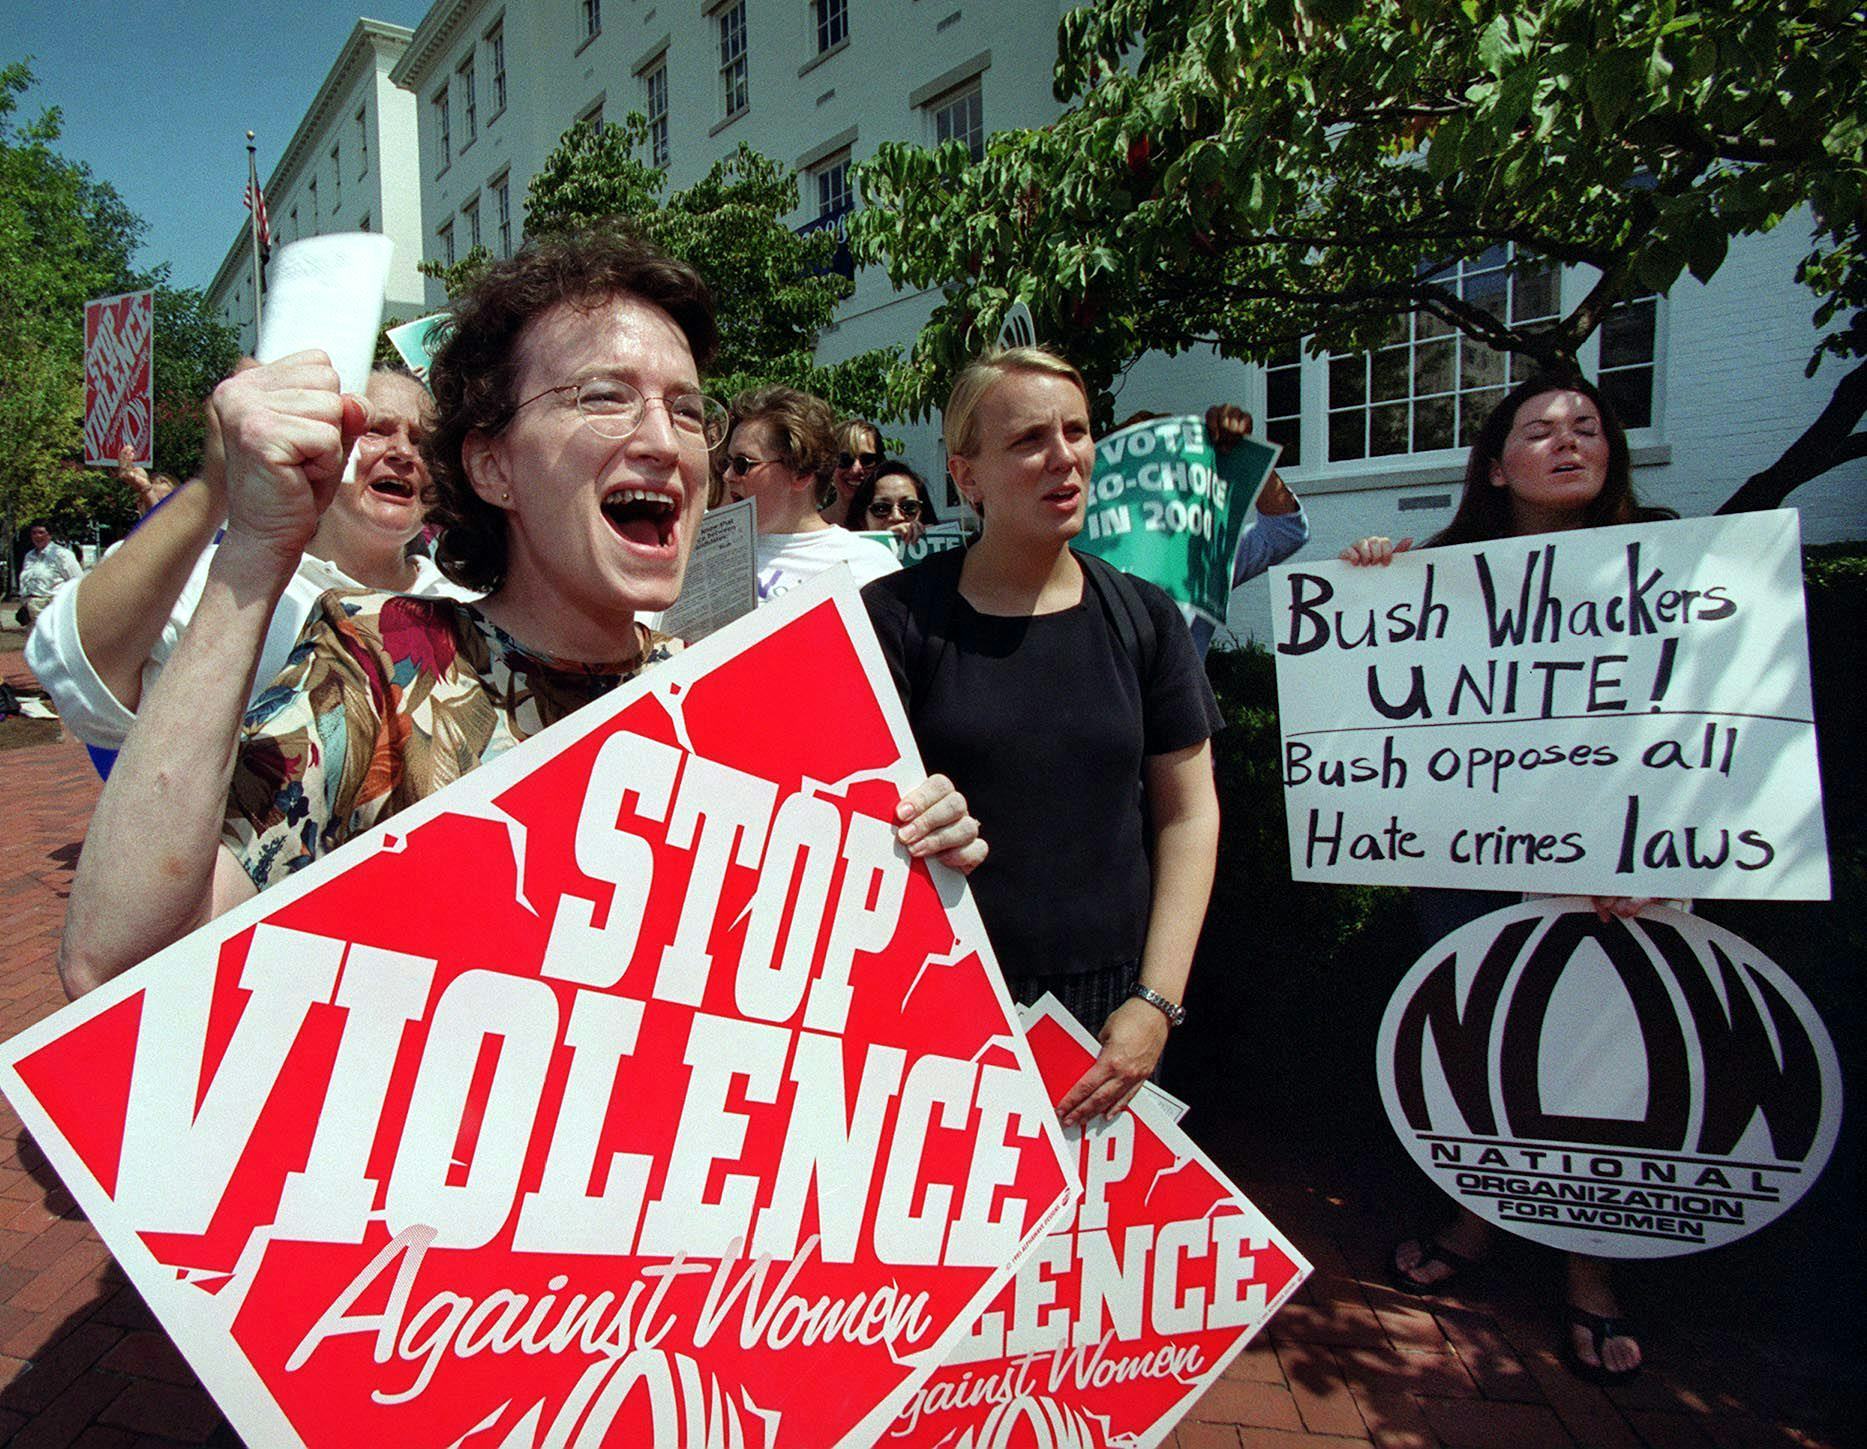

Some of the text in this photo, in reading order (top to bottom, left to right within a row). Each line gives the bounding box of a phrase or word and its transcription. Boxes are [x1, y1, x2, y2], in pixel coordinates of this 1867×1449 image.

[85, 294, 151, 460] VIOLENCE
[1101, 423, 1205, 465] VOTE
[1088, 500, 1212, 541] IN 2000
[1278, 541, 1738, 656] Bush Whackers
[1284, 723, 1738, 793] Bush opposes all
[1306, 795, 1775, 875] Hate crimes laws
[540, 729, 911, 1034] STOP
[1393, 911, 1822, 1163] NOW
[113, 922, 1042, 1267] VIOLENCE
[1432, 1142, 1780, 1194] NATIONAL
[1456, 1173, 1744, 1218] ORGANIZATION
[1498, 1200, 1704, 1236] FOR WOMEN
[285, 1223, 932, 1405] Against Women
[1048, 1329, 1205, 1394] Women
